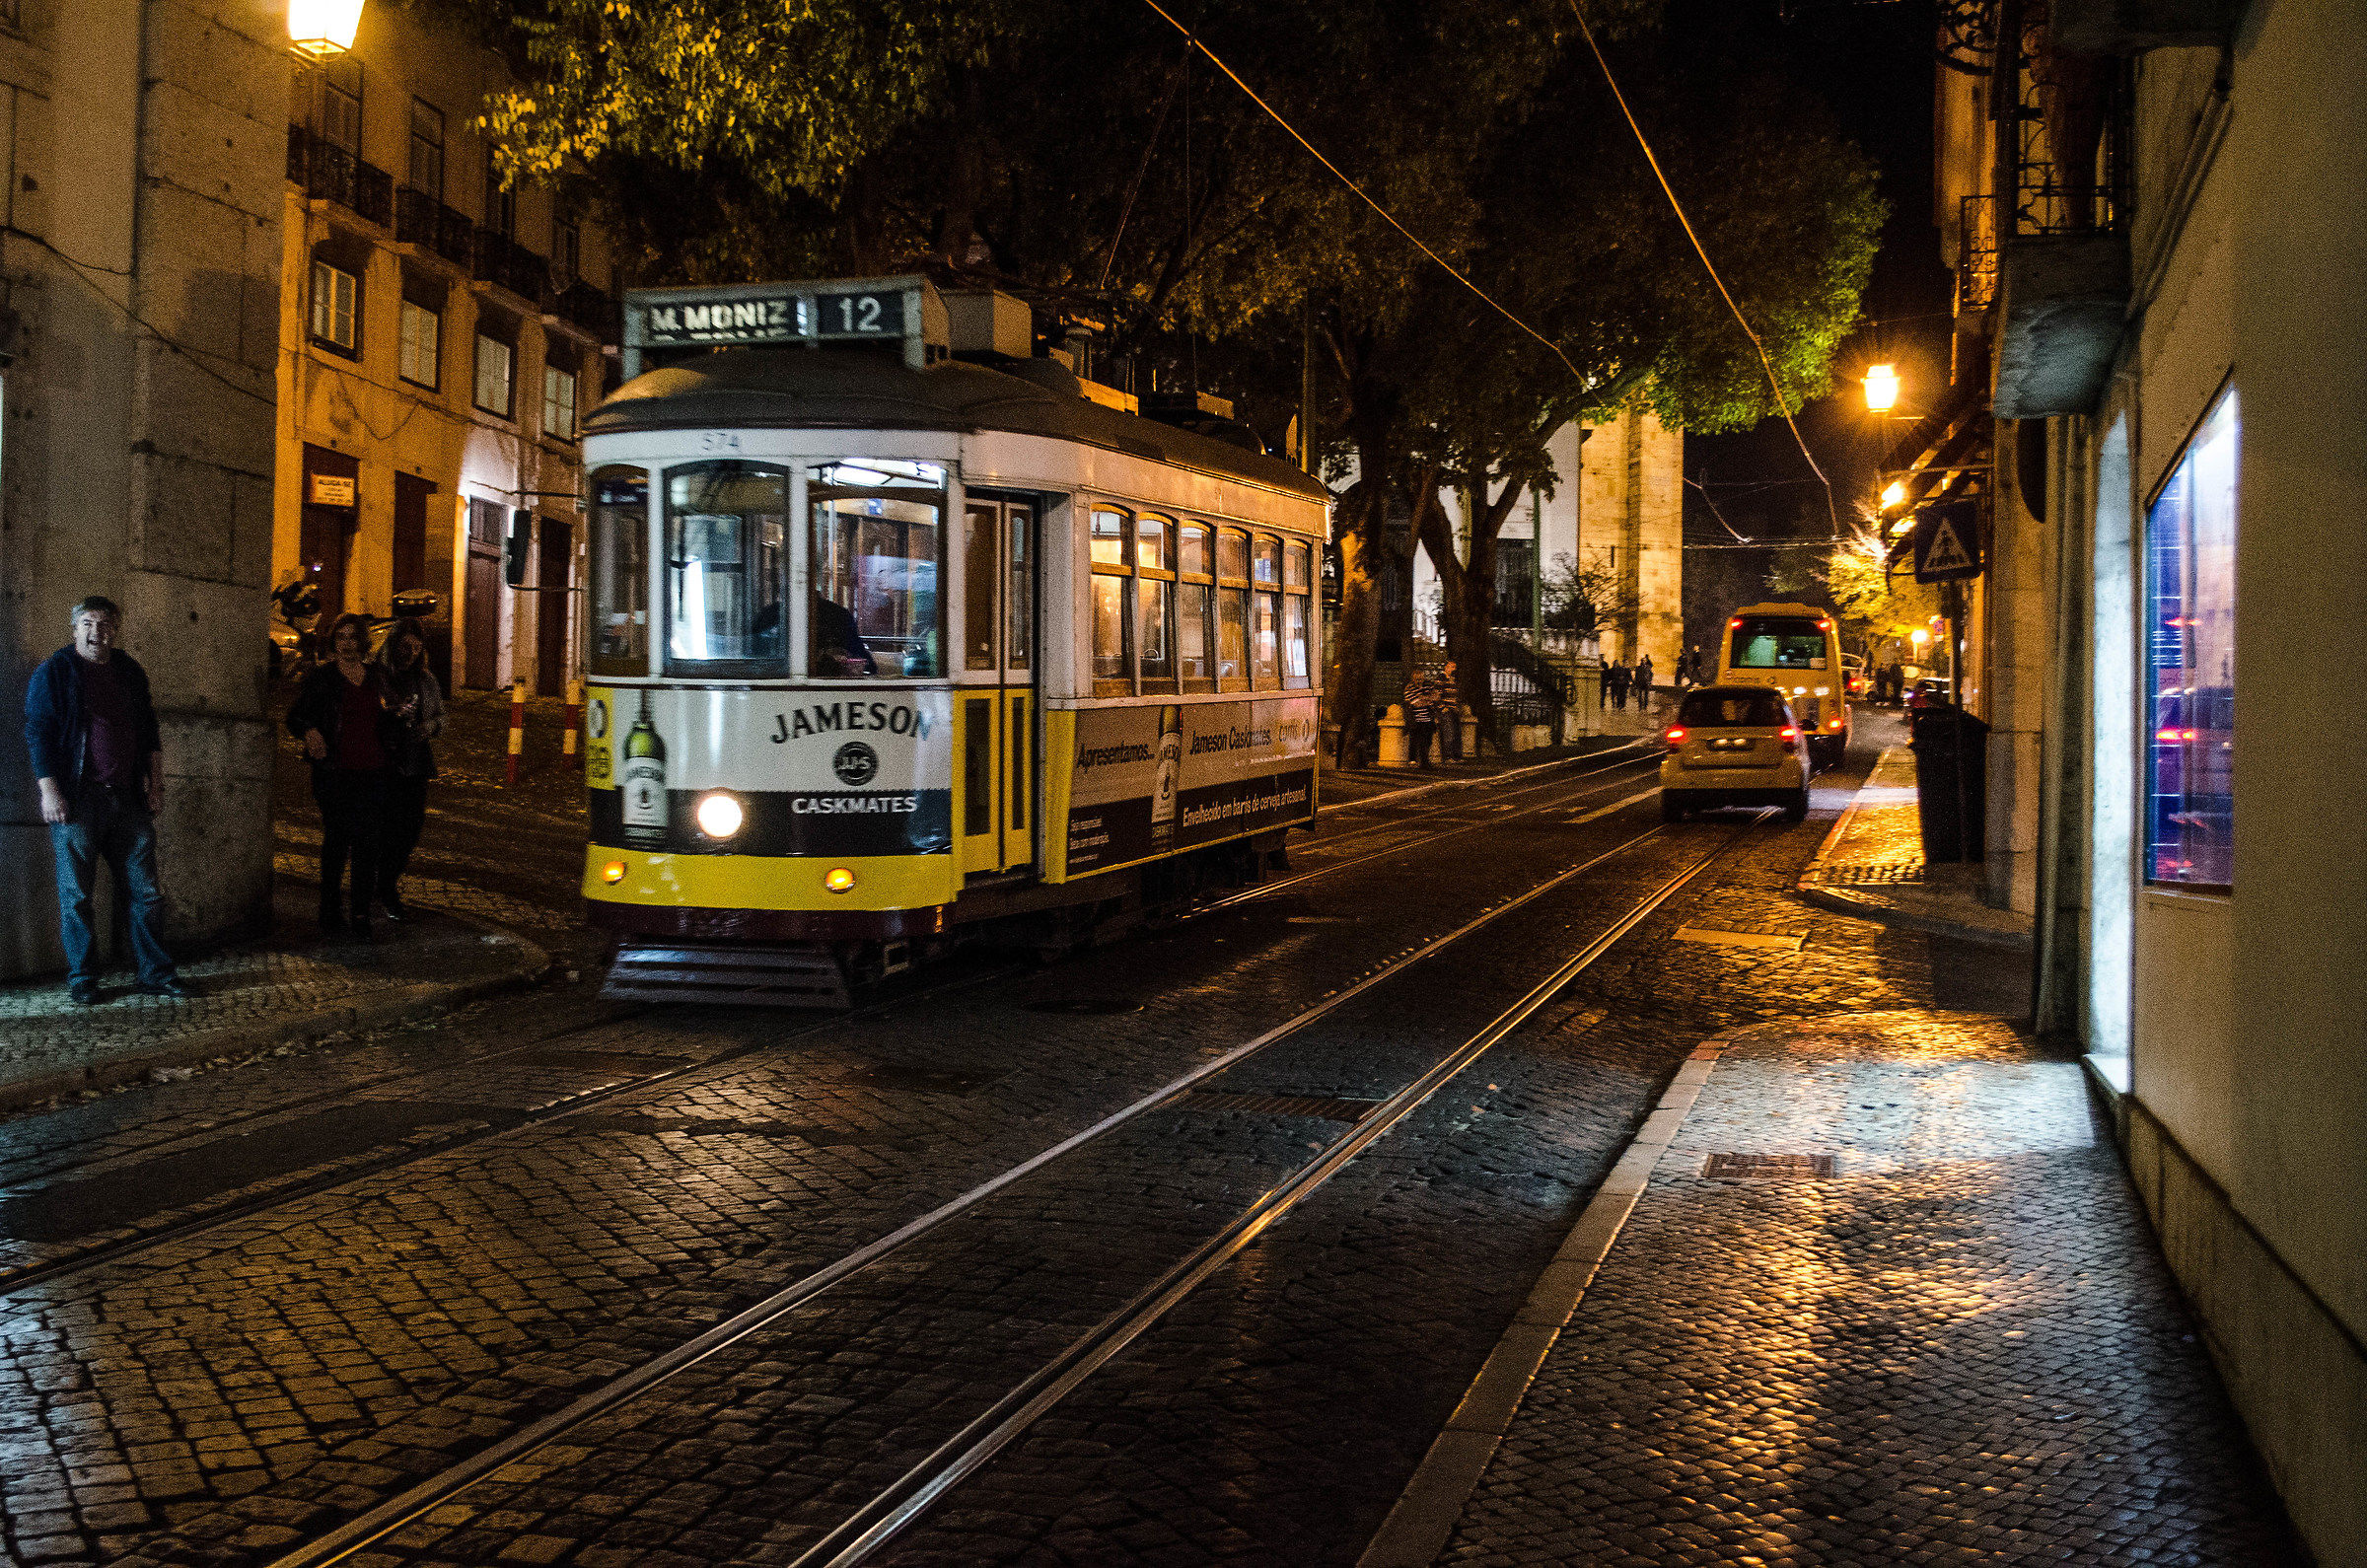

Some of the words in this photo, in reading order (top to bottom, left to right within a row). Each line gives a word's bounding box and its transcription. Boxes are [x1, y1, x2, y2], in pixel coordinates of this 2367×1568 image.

[651, 306, 682, 331] M.
[684, 301, 789, 330] MONIZ
[839, 296, 883, 332] 12
[769, 701, 932, 745] JAMESON
[1189, 730, 1228, 755] Jameson
[791, 797, 919, 815] CASKMATES
[1183, 799, 1221, 827] Envelhecido
[1222, 803, 1232, 819] em
[1232, 796, 1252, 817] barris
[1252, 793, 1259, 812] de
[1259, 794, 1281, 812] cerveja
